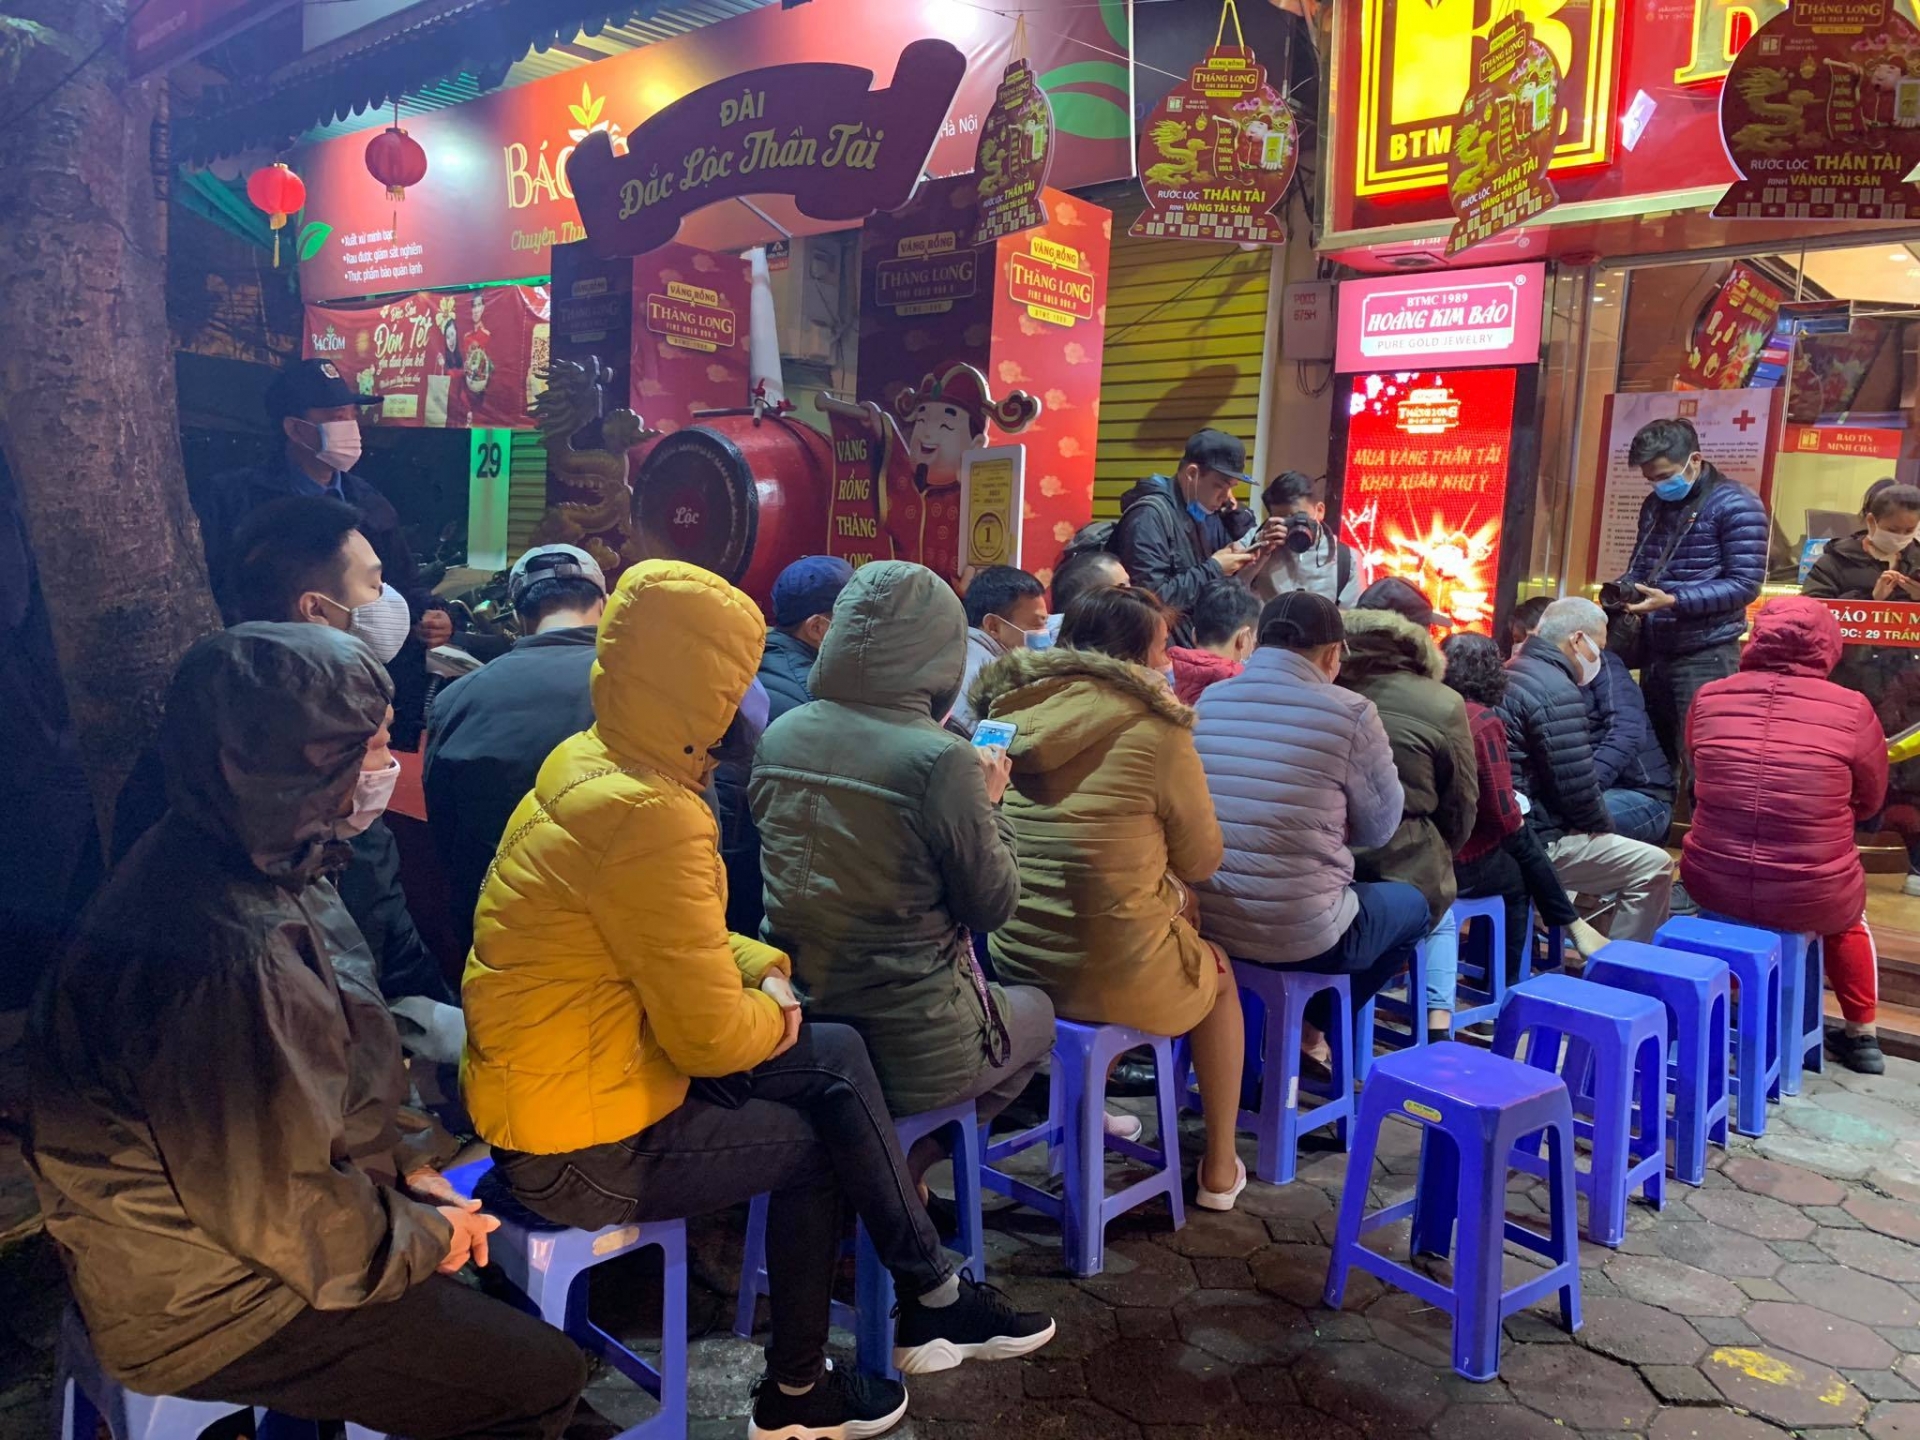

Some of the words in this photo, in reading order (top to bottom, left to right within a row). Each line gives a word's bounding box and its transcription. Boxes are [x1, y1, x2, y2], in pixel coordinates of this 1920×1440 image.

[1845, 4, 1881, 16] LONG
[1230, 74, 1255, 84] LONG
[720, 89, 765, 127] ĐÀI
[940, 120, 955, 138] Hà
[960, 114, 978, 134] Nội
[1390, 125, 1452, 162] BTM
[618, 163, 674, 220] Đắc
[680, 146, 735, 191] Lộc
[739, 126, 818, 174] Thần
[821, 122, 885, 170] Tài
[1522, 156, 1538, 175] TÀI
[1751, 158, 1784, 170] RƯỚC
[1786, 158, 1809, 170] LỘC
[1814, 152, 1867, 170] THẦN
[1872, 153, 1901, 170] TÀI
[504, 140, 576, 209] BÁC
[1790, 175, 1827, 185] VÀNG
[1830, 174, 1851, 185] TÀI
[1853, 174, 1881, 186] SẢN
[1158, 189, 1182, 199] RƯỚC
[1183, 190, 1199, 200] LỘC
[1202, 188, 1240, 202] THẦN
[1244, 189, 1266, 202] TÀI
[1186, 204, 1212, 212] VÀNG
[1214, 204, 1228, 213] TÀI
[1230, 204, 1250, 214] SẢN
[367, 230, 382, 241] minh
[511, 226, 556, 254] Chuyên
[900, 239, 925, 253] VÀNG
[1034, 241, 1054, 257] VÀNG
[1056, 247, 1076, 264] RỒNG
[932, 261, 973, 282] LONG
[670, 284, 692, 297] VÀNG
[694, 290, 716, 303] RỒNG
[1013, 263, 1057, 291] THĂNG
[1059, 280, 1091, 303] LONG
[1406, 294, 1438, 306] BTMC
[1441, 293, 1468, 304] 1989
[650, 302, 696, 324] THĂNG
[698, 315, 732, 334] LONG
[1367, 307, 1426, 332] HOÀNG
[1429, 308, 1464, 327] KIM
[1468, 299, 1509, 324] BẢO
[374, 322, 404, 358] Đón
[409, 308, 433, 350] Tết
[1378, 340, 1404, 349] PURE
[1409, 338, 1439, 348] GOLD
[1444, 334, 1493, 346] JEWELRY
[1827, 443, 1852, 451] MINH
[1854, 442, 1879, 453] CHÂU
[1836, 433, 1855, 442] BẢO
[1858, 433, 1872, 442] TÍN
[836, 435, 867, 462] VÀNG
[1353, 449, 1384, 465] MUA
[1390, 447, 1428, 465] VÀNG
[1477, 443, 1502, 464] TÀI
[476, 442, 502, 478] 29
[838, 468, 870, 500] RỒNG
[1360, 474, 1394, 492] KHAI
[1398, 472, 1438, 490] XUÂN
[1442, 474, 1476, 491] NHƯ
[1480, 471, 1489, 492] Ý
[674, 506, 699, 528] Lộc
[836, 512, 876, 538] THĂNG
[985, 526, 991, 543] 1
[1830, 606, 1867, 622] BẢO
[1871, 608, 1903, 624] TÍN
[1865, 630, 1880, 639] 29
